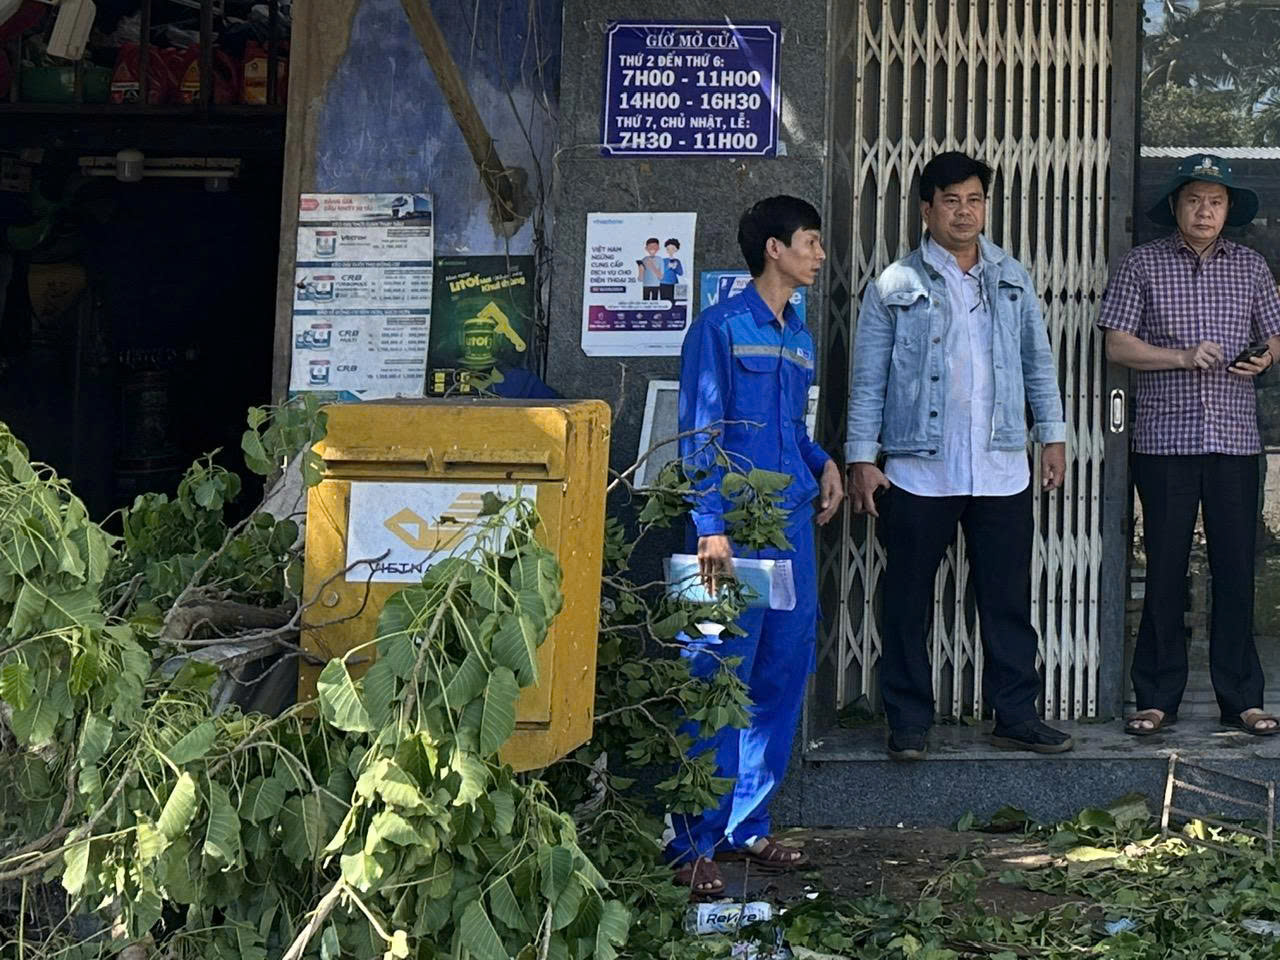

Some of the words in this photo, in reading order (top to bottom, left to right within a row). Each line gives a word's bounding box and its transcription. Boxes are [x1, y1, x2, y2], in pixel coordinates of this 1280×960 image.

[646, 32, 674, 47] GIỜ
[679, 30, 703, 47] MỞ
[707, 31, 739, 48] CỬA
[619, 53, 644, 67] THỨ
[646, 56, 655, 66] 2
[658, 51, 682, 67] ĐẾN
[686, 53, 710, 67] THỨ
[713, 56, 725, 67] 6:
[622, 70, 675, 86] 7H00
[696, 70, 760, 87] 11H00
[619, 92, 680, 109] 14H00
[700, 93, 761, 110] 16H30
[616, 114, 642, 128] THỨ
[645, 117, 657, 130] 7,
[660, 113, 685, 128] CHỦ
[690, 114, 727, 130] NHẬT,
[730, 112, 750, 128] LỄ:
[619, 132, 672, 149] 7H30
[694, 132, 758, 149] 11H00
